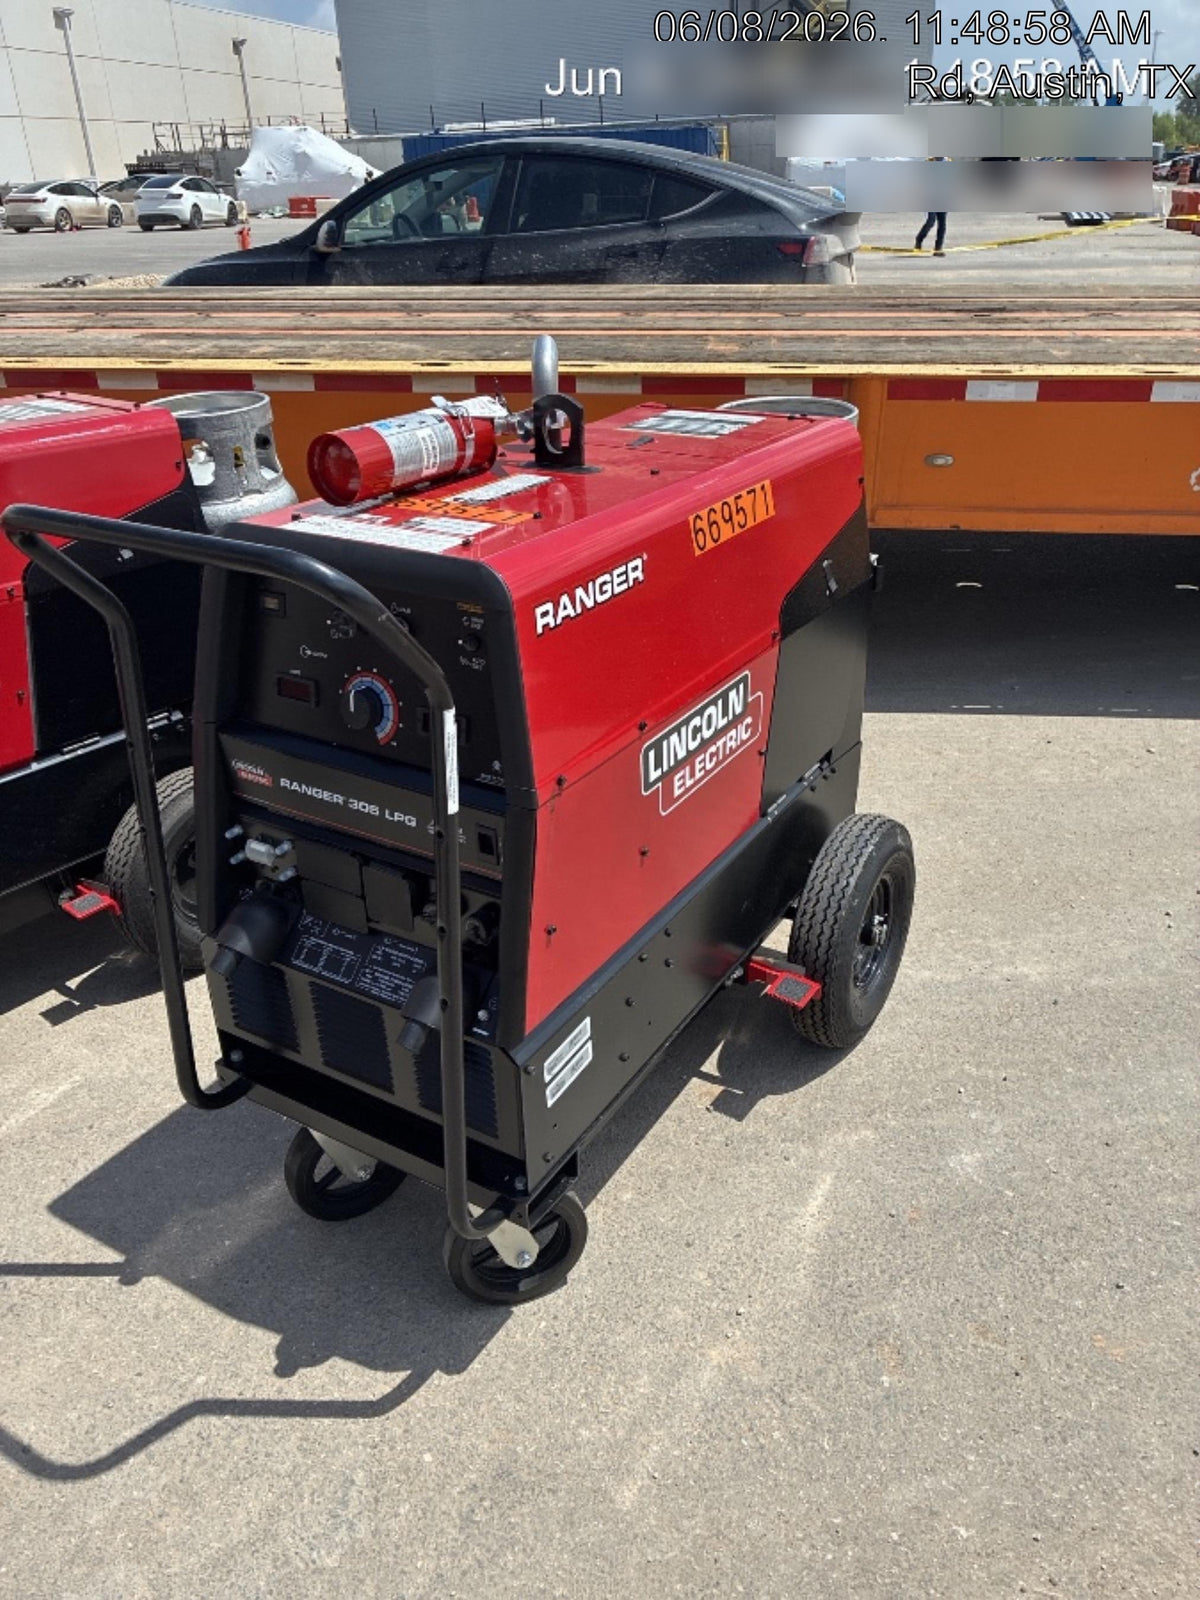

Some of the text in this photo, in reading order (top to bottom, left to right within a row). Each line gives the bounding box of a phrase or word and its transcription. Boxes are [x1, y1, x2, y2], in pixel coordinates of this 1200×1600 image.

[691, 482, 772, 552] 669571
[534, 555, 646, 637] RANGER
[648, 682, 744, 783] LINCOLN
[673, 715, 753, 799] ELECTRIC
[279, 777, 344, 806] RANGER
[384, 807, 417, 827] LPG
